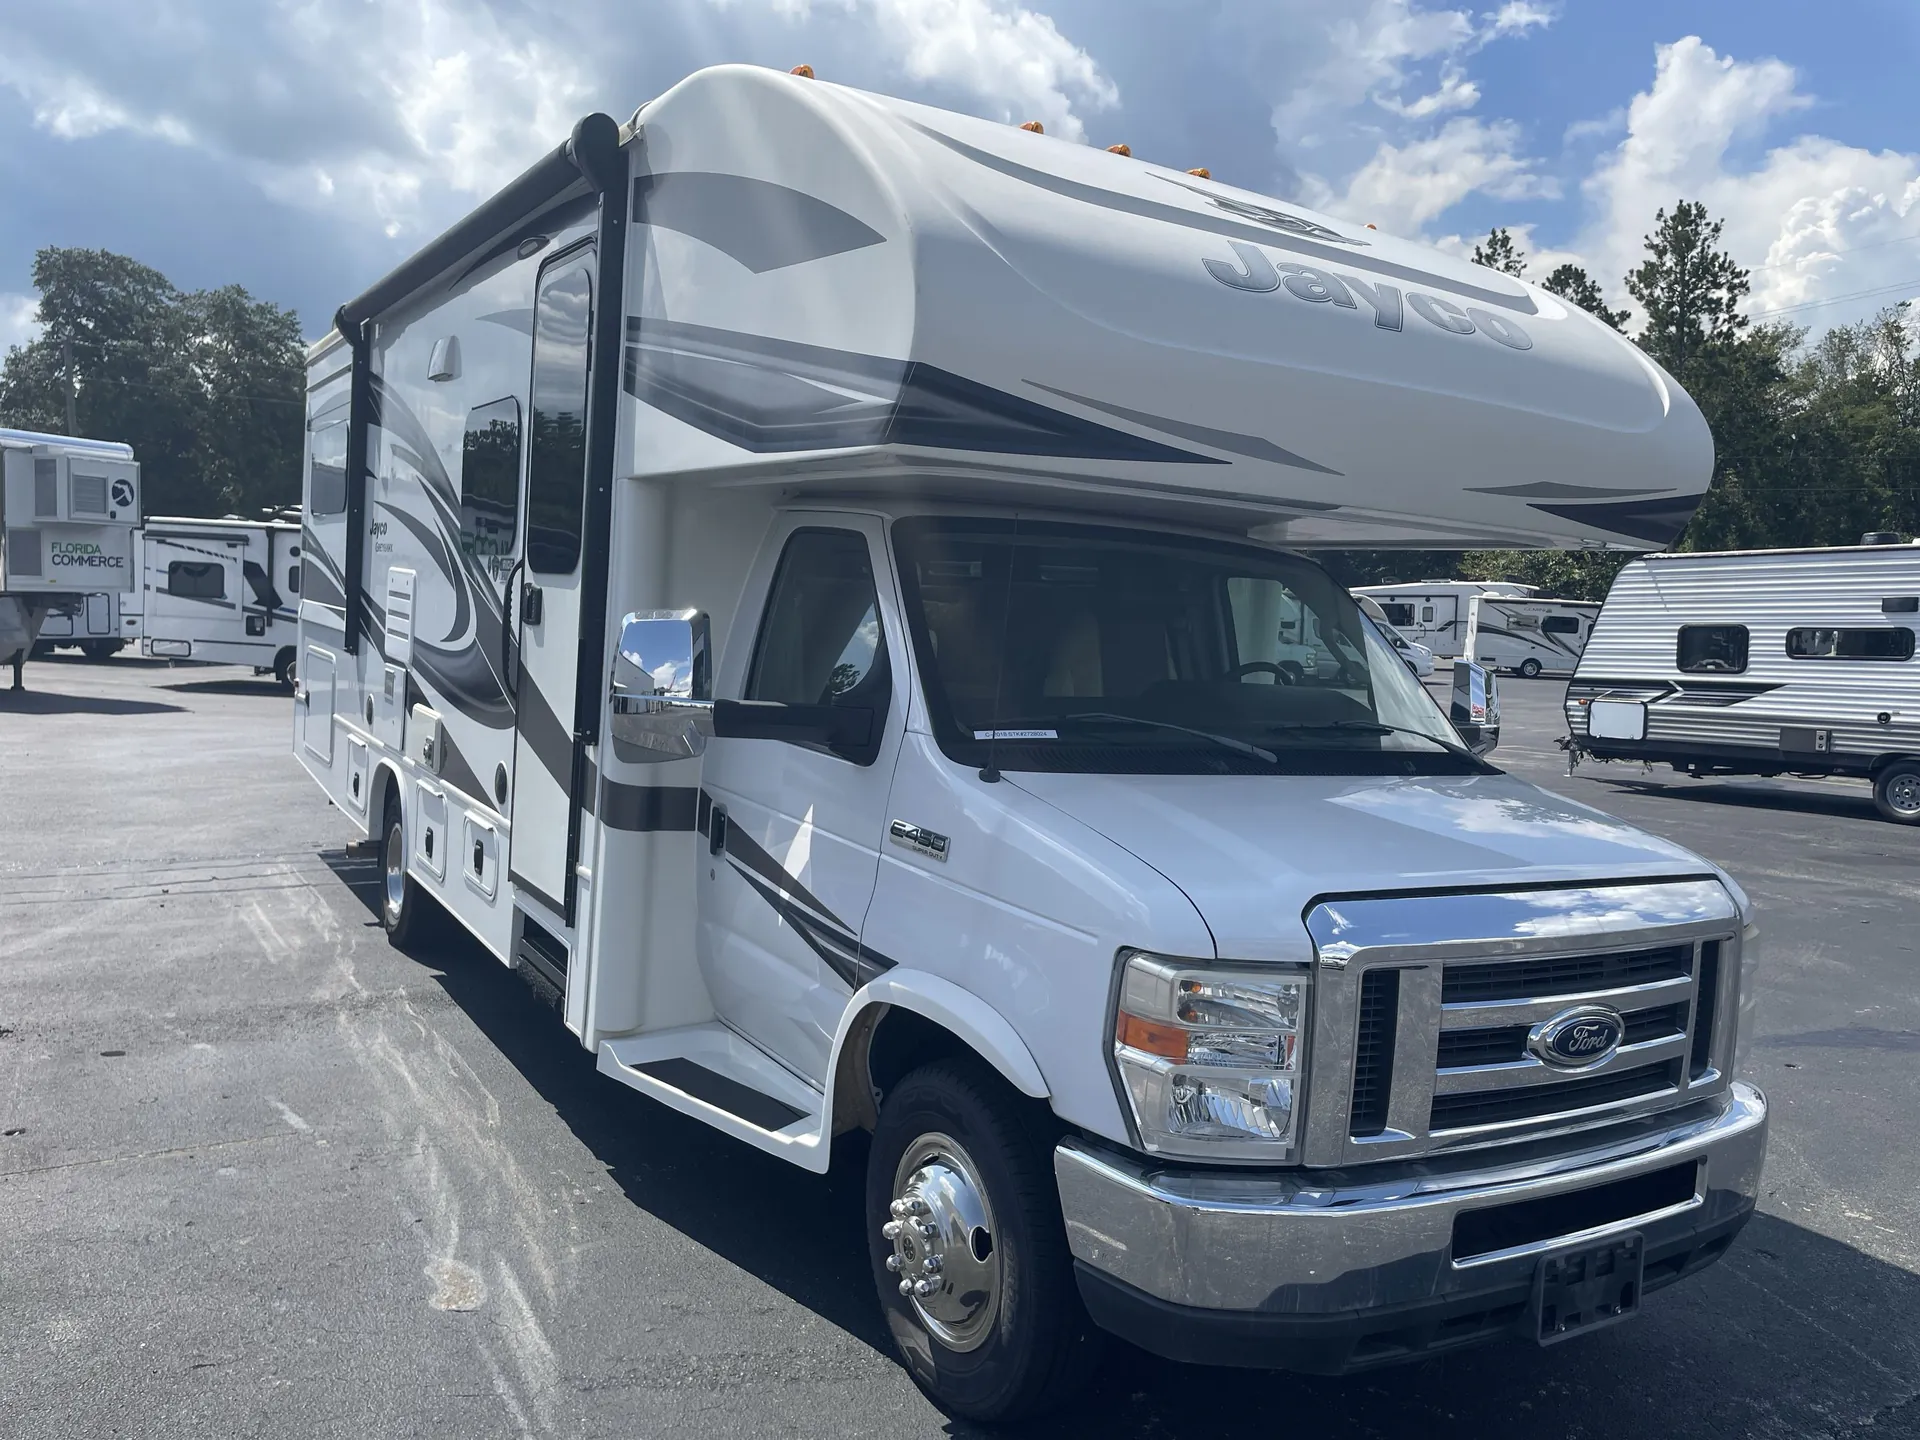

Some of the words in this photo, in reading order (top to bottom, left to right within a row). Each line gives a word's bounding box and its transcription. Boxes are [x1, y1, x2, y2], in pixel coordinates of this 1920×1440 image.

[1201, 239, 1533, 350] Jayco
[370, 518, 388, 539] Jayco
[51, 541, 102, 555] FLORIDA
[51, 553, 124, 569] COMMERCE
[1568, 1024, 1609, 1052] Ford
